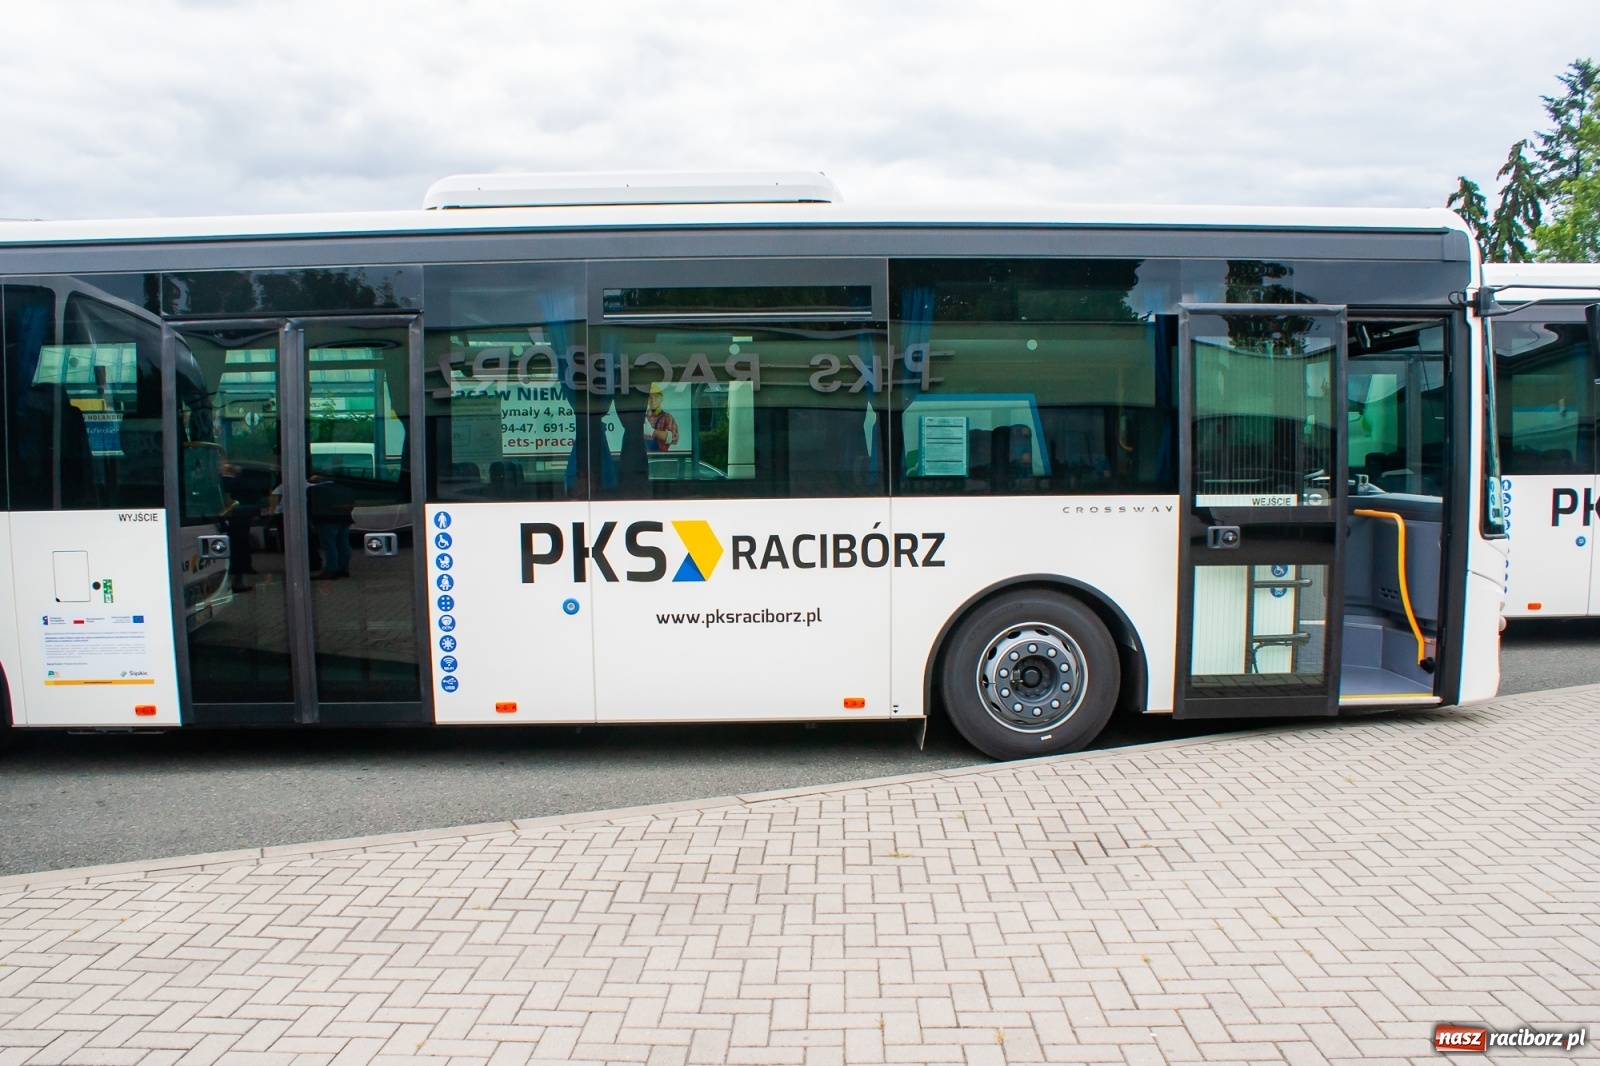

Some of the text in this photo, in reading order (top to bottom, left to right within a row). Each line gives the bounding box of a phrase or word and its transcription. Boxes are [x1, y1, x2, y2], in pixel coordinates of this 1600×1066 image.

[543, 407, 554, 417] 4,
[1252, 495, 1291, 506] WEJŚCIE
[1062, 505, 1173, 514] CROSSWAY
[118, 513, 158, 522] WYJŚCIE
[520, 521, 945, 584] PKS RACIBÓRZ
[656, 608, 822, 628] www.pksraciborz.pl
